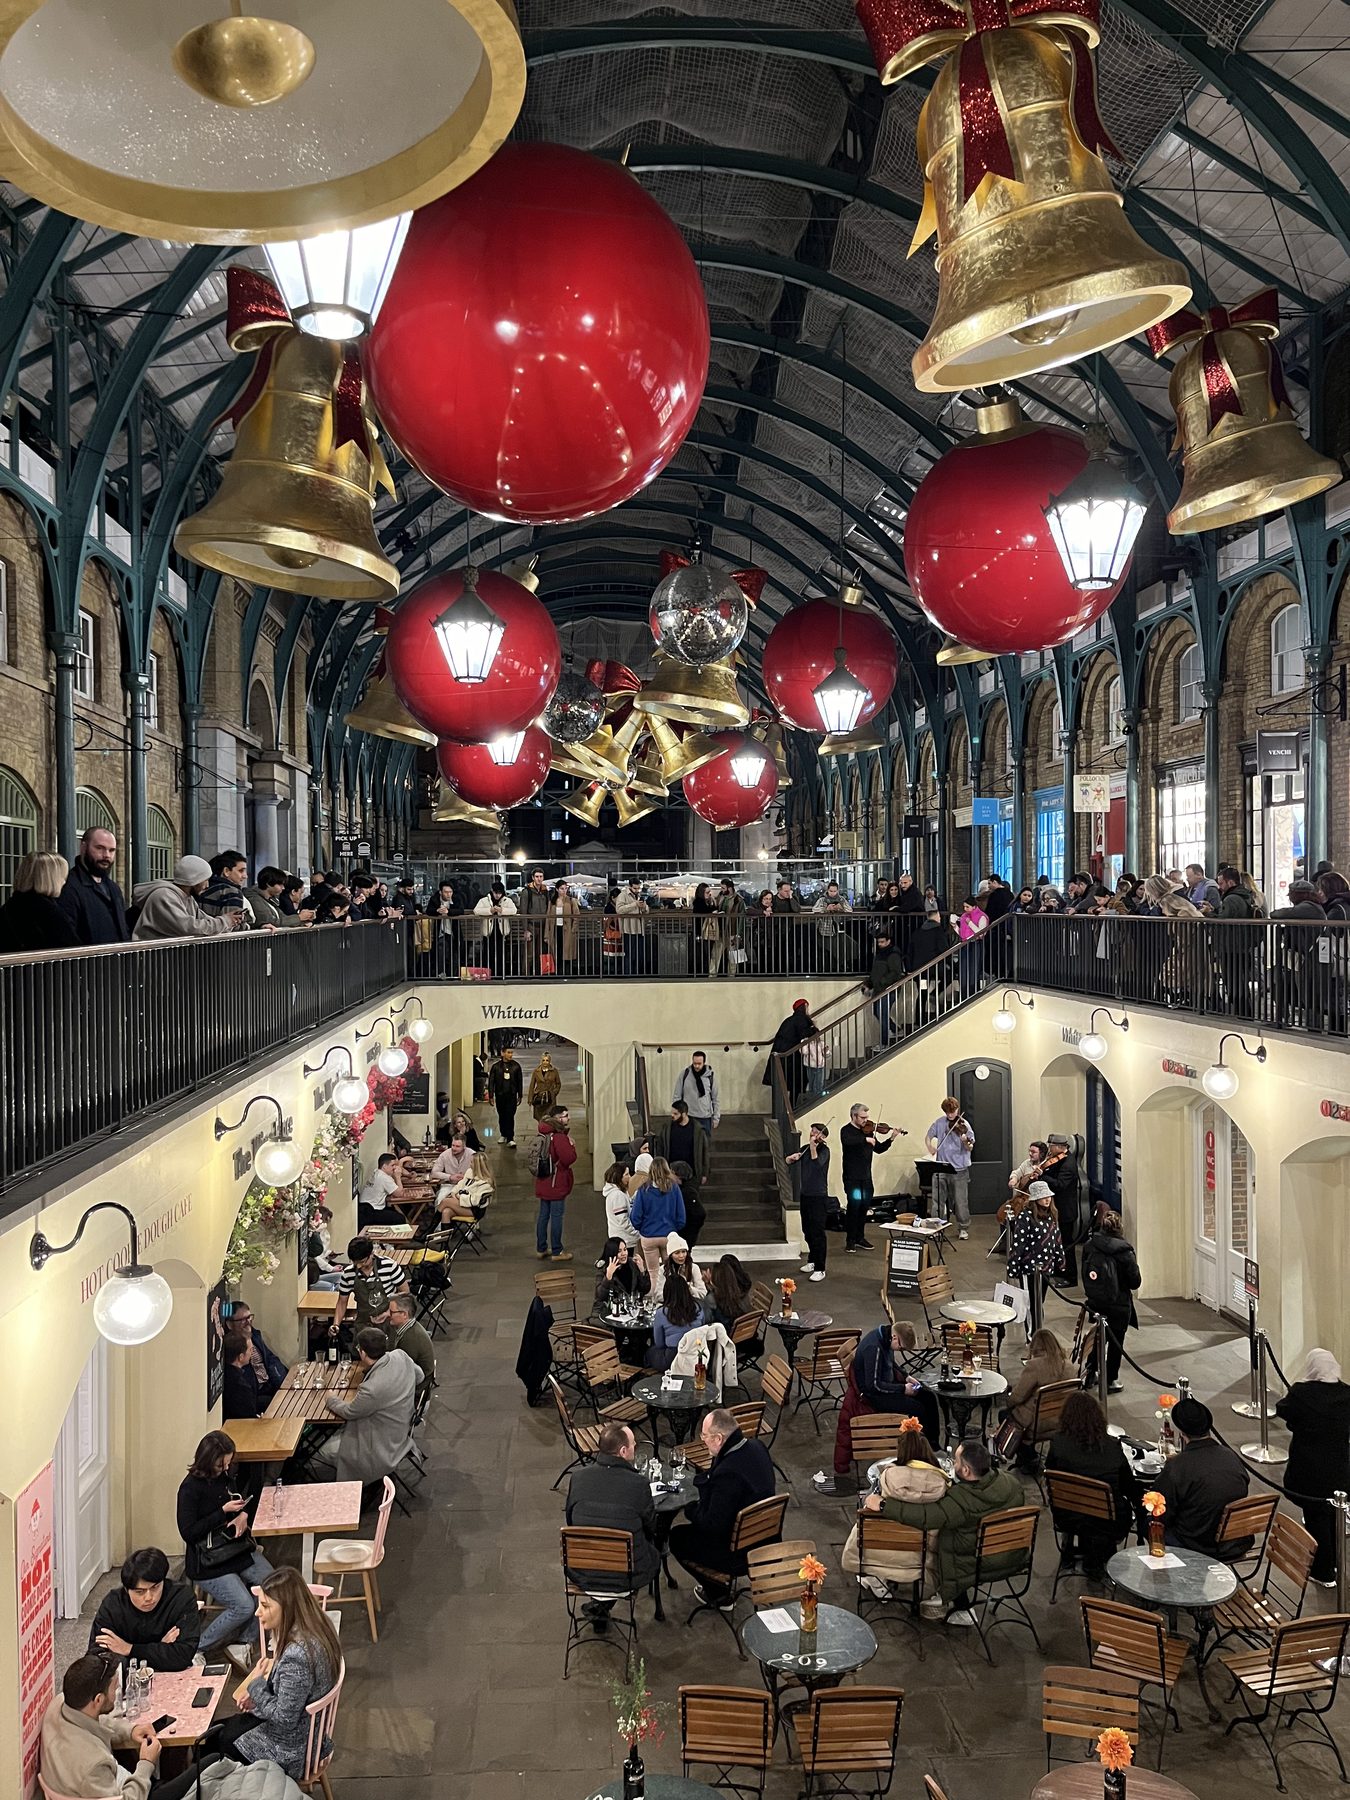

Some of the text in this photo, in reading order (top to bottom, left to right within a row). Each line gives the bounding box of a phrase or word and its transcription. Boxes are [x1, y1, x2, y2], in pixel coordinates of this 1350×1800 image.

[1172, 766, 1201, 784] Venchi
[481, 1005, 550, 1020] Whittard
[1062, 1026, 1082, 1046] Whitt
[81, 1264, 104, 1304] HOT
[106, 1233, 143, 1280] COOE
[144, 1208, 174, 1249] DOUGH
[21, 1545, 51, 1604] HOT
[21, 1587, 52, 1636] SUNDAES
[21, 1609, 52, 1671] ICE CREAM
[21, 1632, 52, 1688] SHAKES
[28, 1647, 52, 1691] CONES
[22, 1671, 53, 1728] COFFEE
